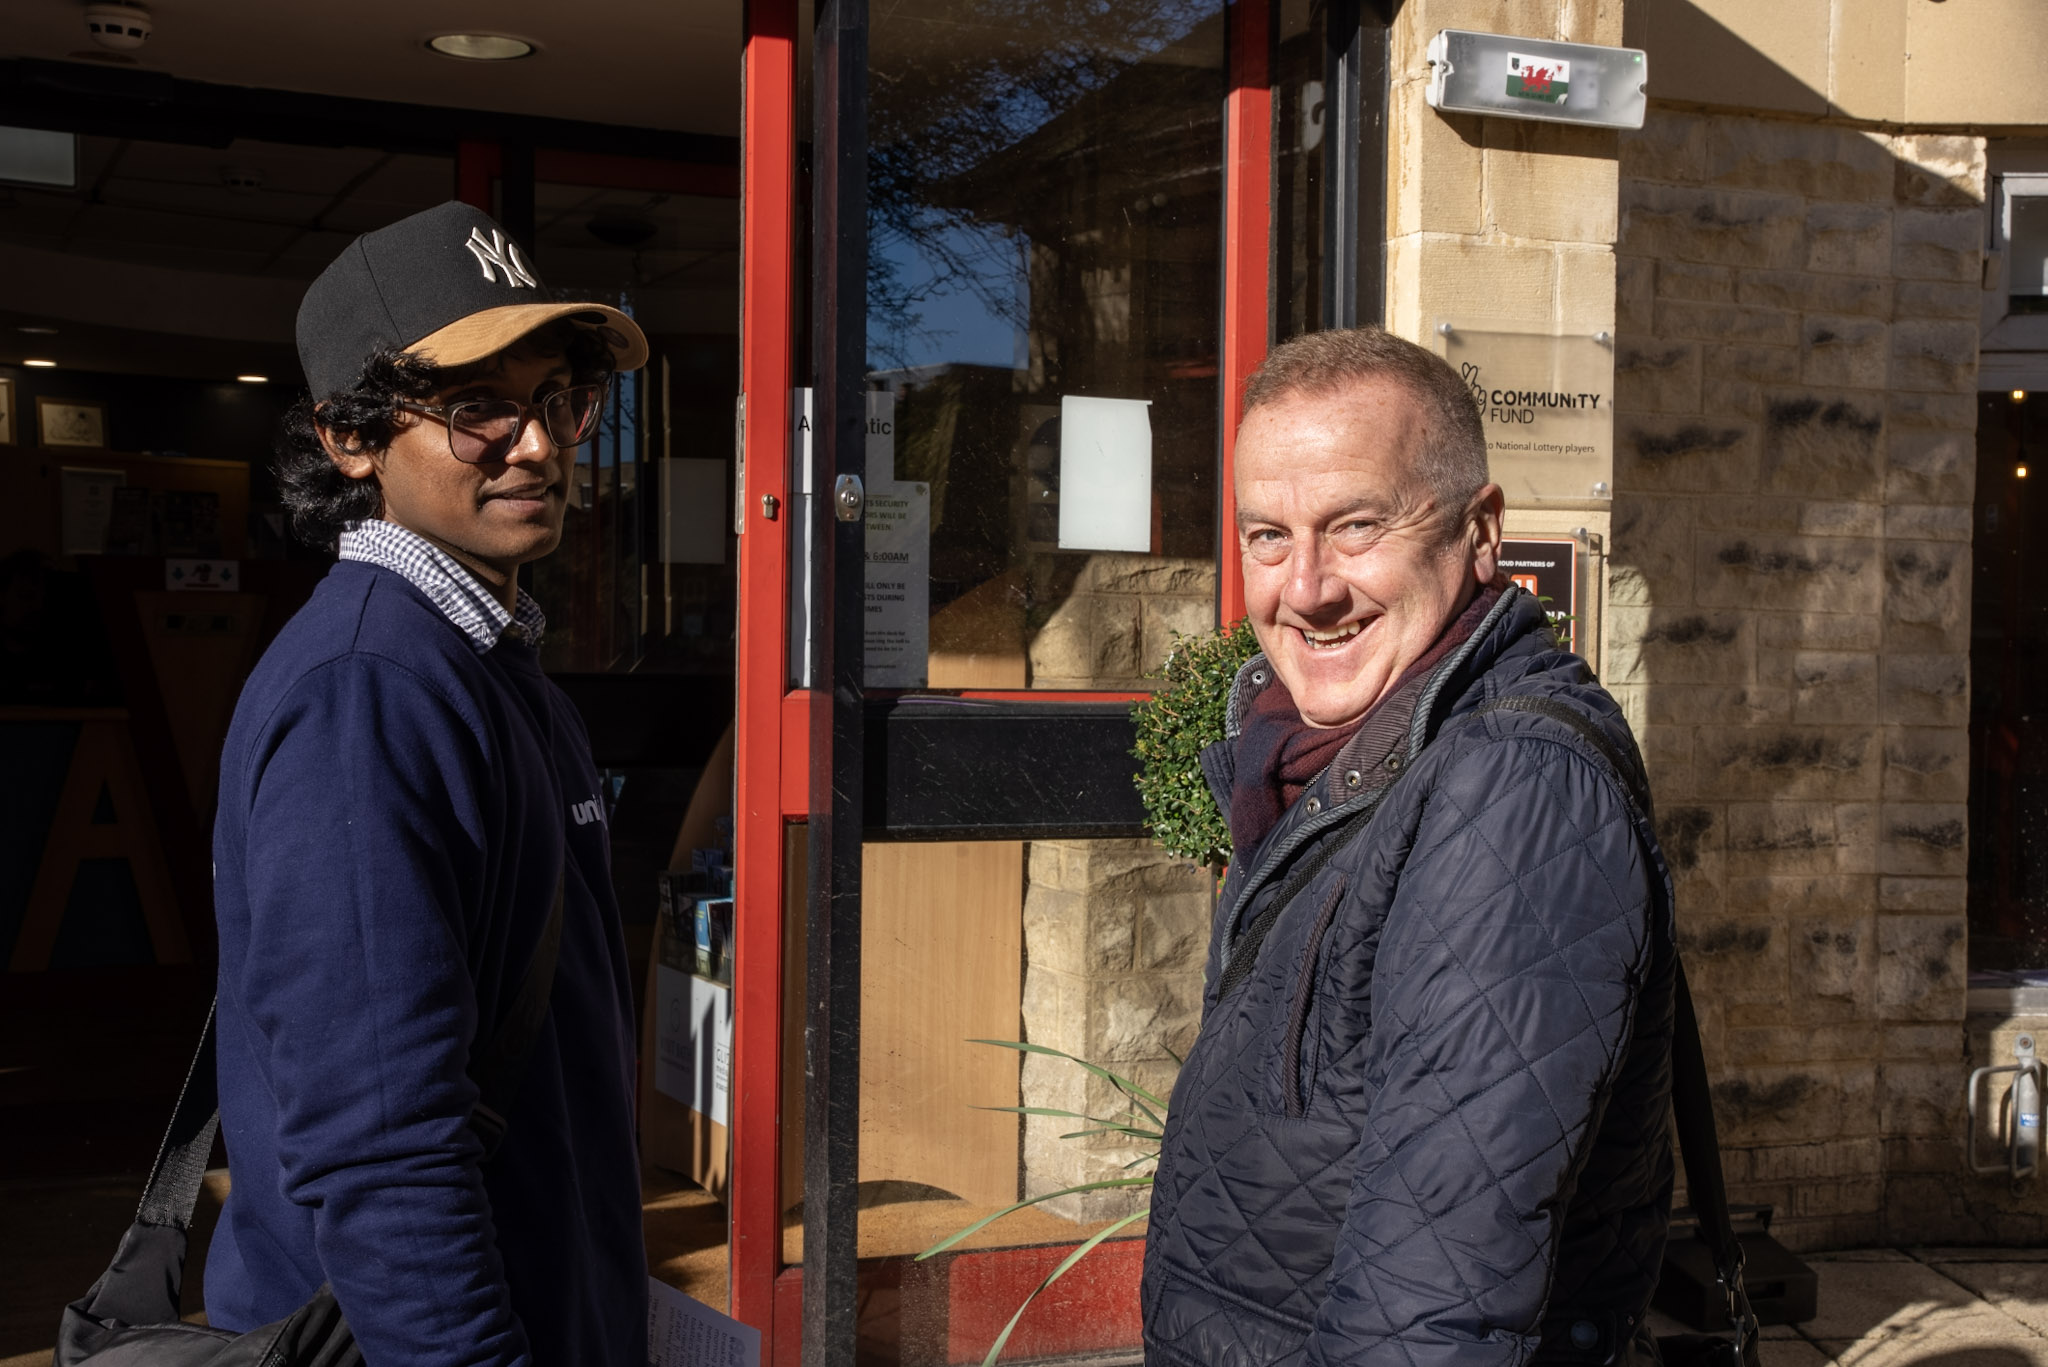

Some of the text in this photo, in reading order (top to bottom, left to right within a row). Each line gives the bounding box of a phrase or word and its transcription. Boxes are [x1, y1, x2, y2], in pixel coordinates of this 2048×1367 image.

[464, 226, 537, 288] NY
[1491, 390, 1600, 409] COMMUNITY
[1491, 408, 1534, 424] FUND
[865, 418, 892, 435] tic
[1495, 441, 1531, 451] National
[1533, 442, 1564, 454] Lottery
[1565, 444, 1595, 455] players
[875, 500, 909, 508] SECURITY
[898, 512, 906, 520] BE
[873, 551, 909, 561] 6:00AM
[877, 594, 905, 602] DURING
